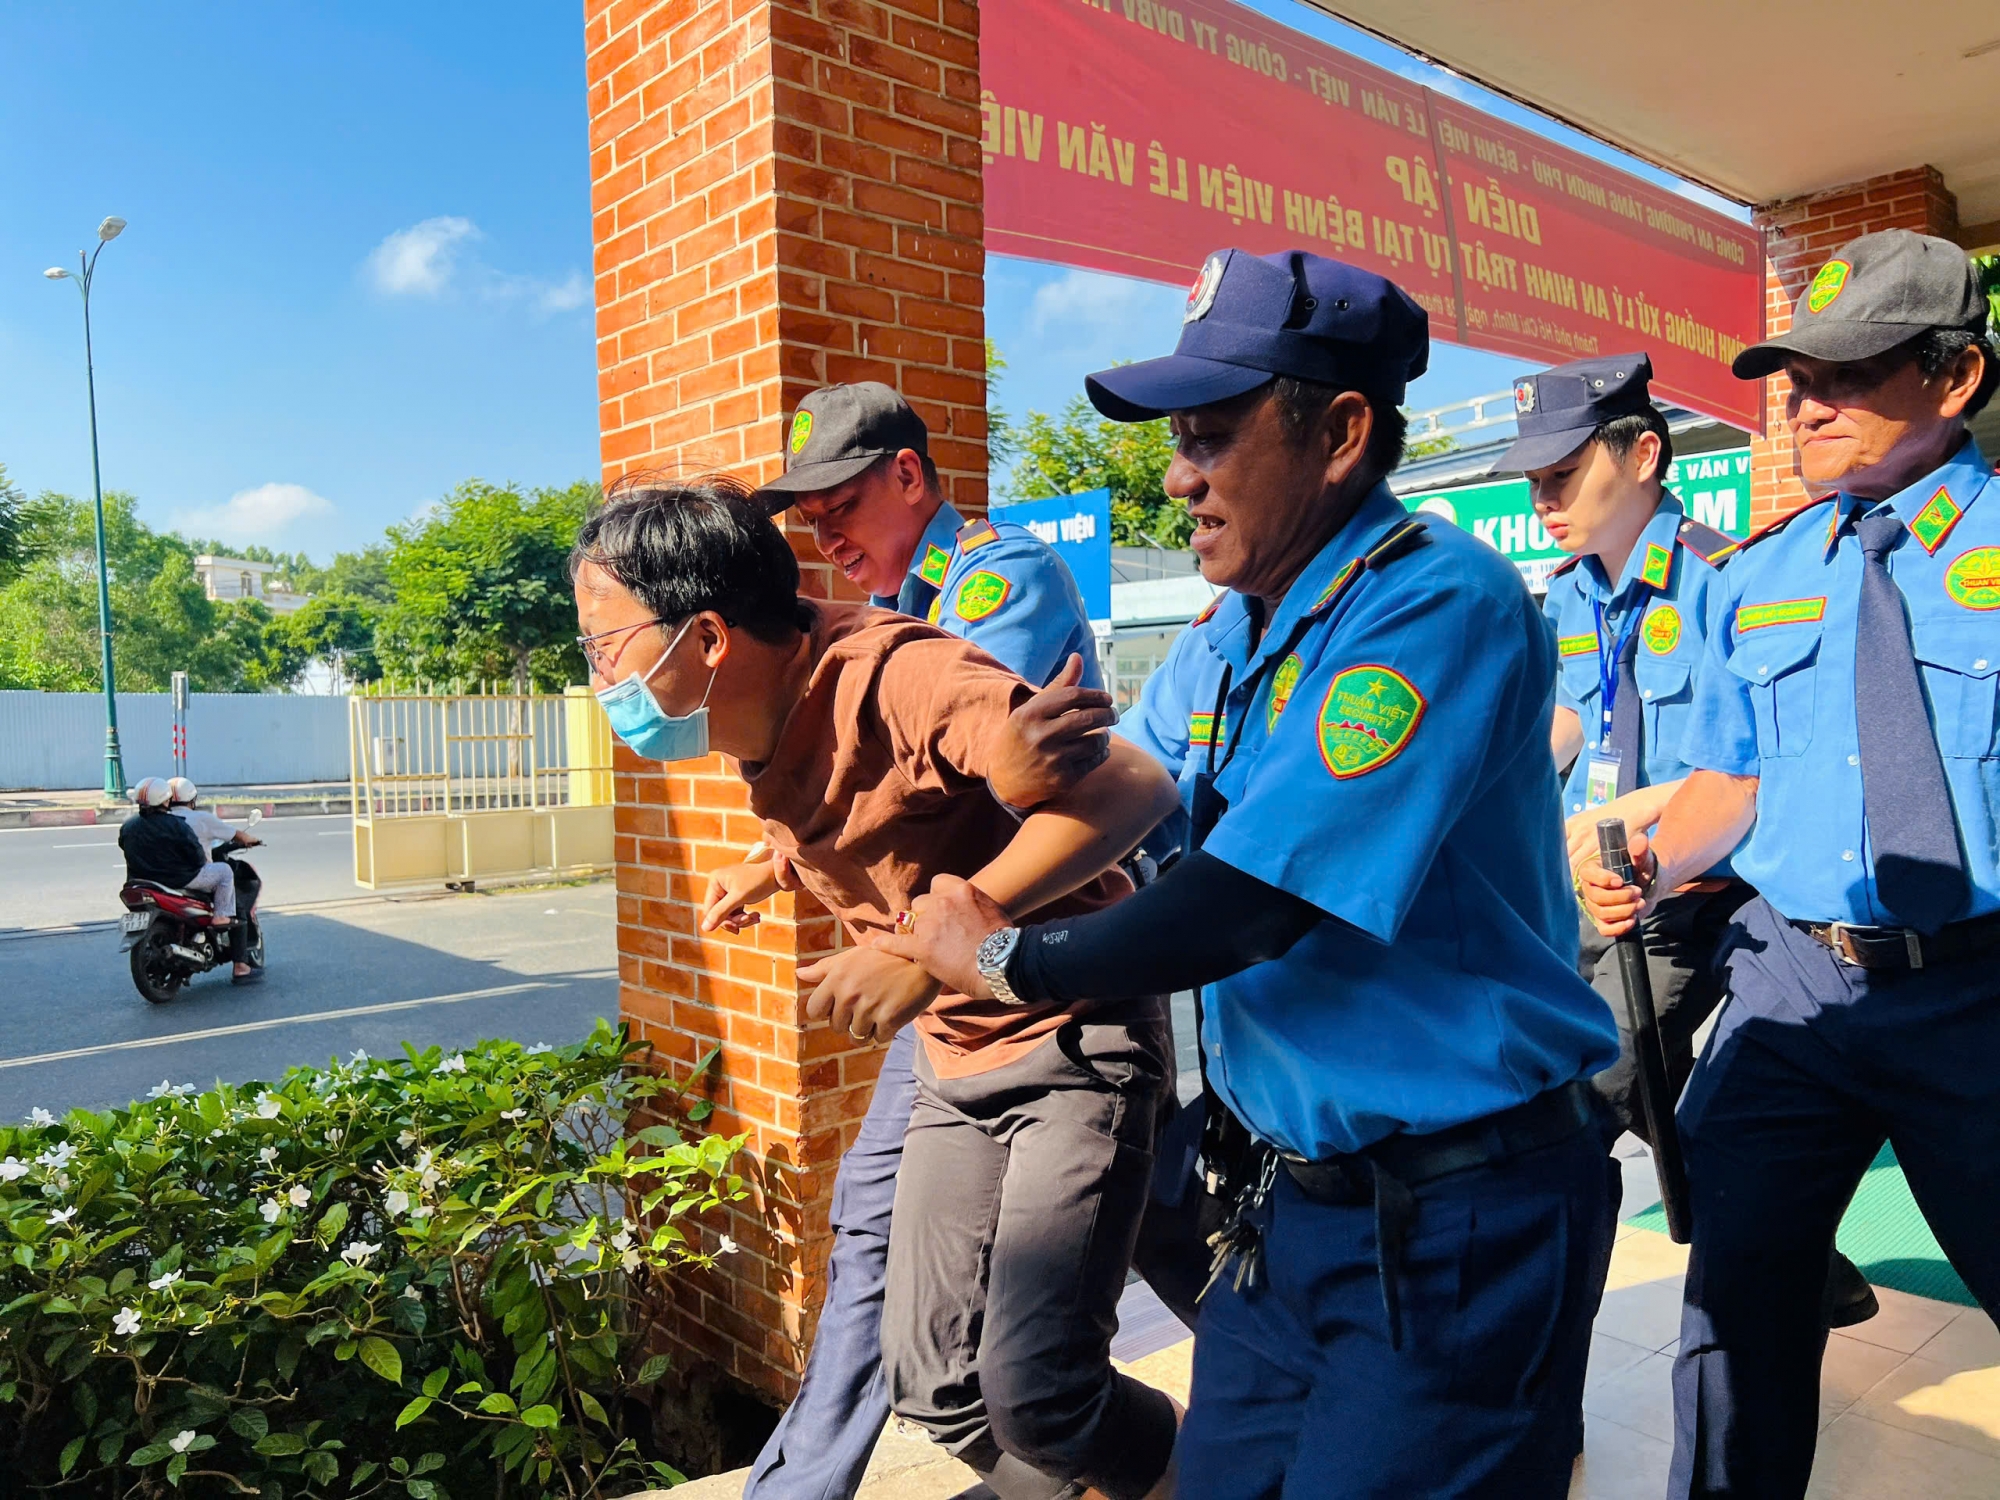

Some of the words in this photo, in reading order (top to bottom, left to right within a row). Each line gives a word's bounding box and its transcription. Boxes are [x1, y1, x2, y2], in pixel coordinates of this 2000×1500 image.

[1685, 456, 1730, 481] VĂN
[1735, 455, 1751, 475] V
[1060, 512, 1095, 544] VIỆN
[1473, 512, 1557, 555] KHO
[1338, 705, 1395, 729] SECURITY
[1379, 703, 1410, 721] VIỆT
